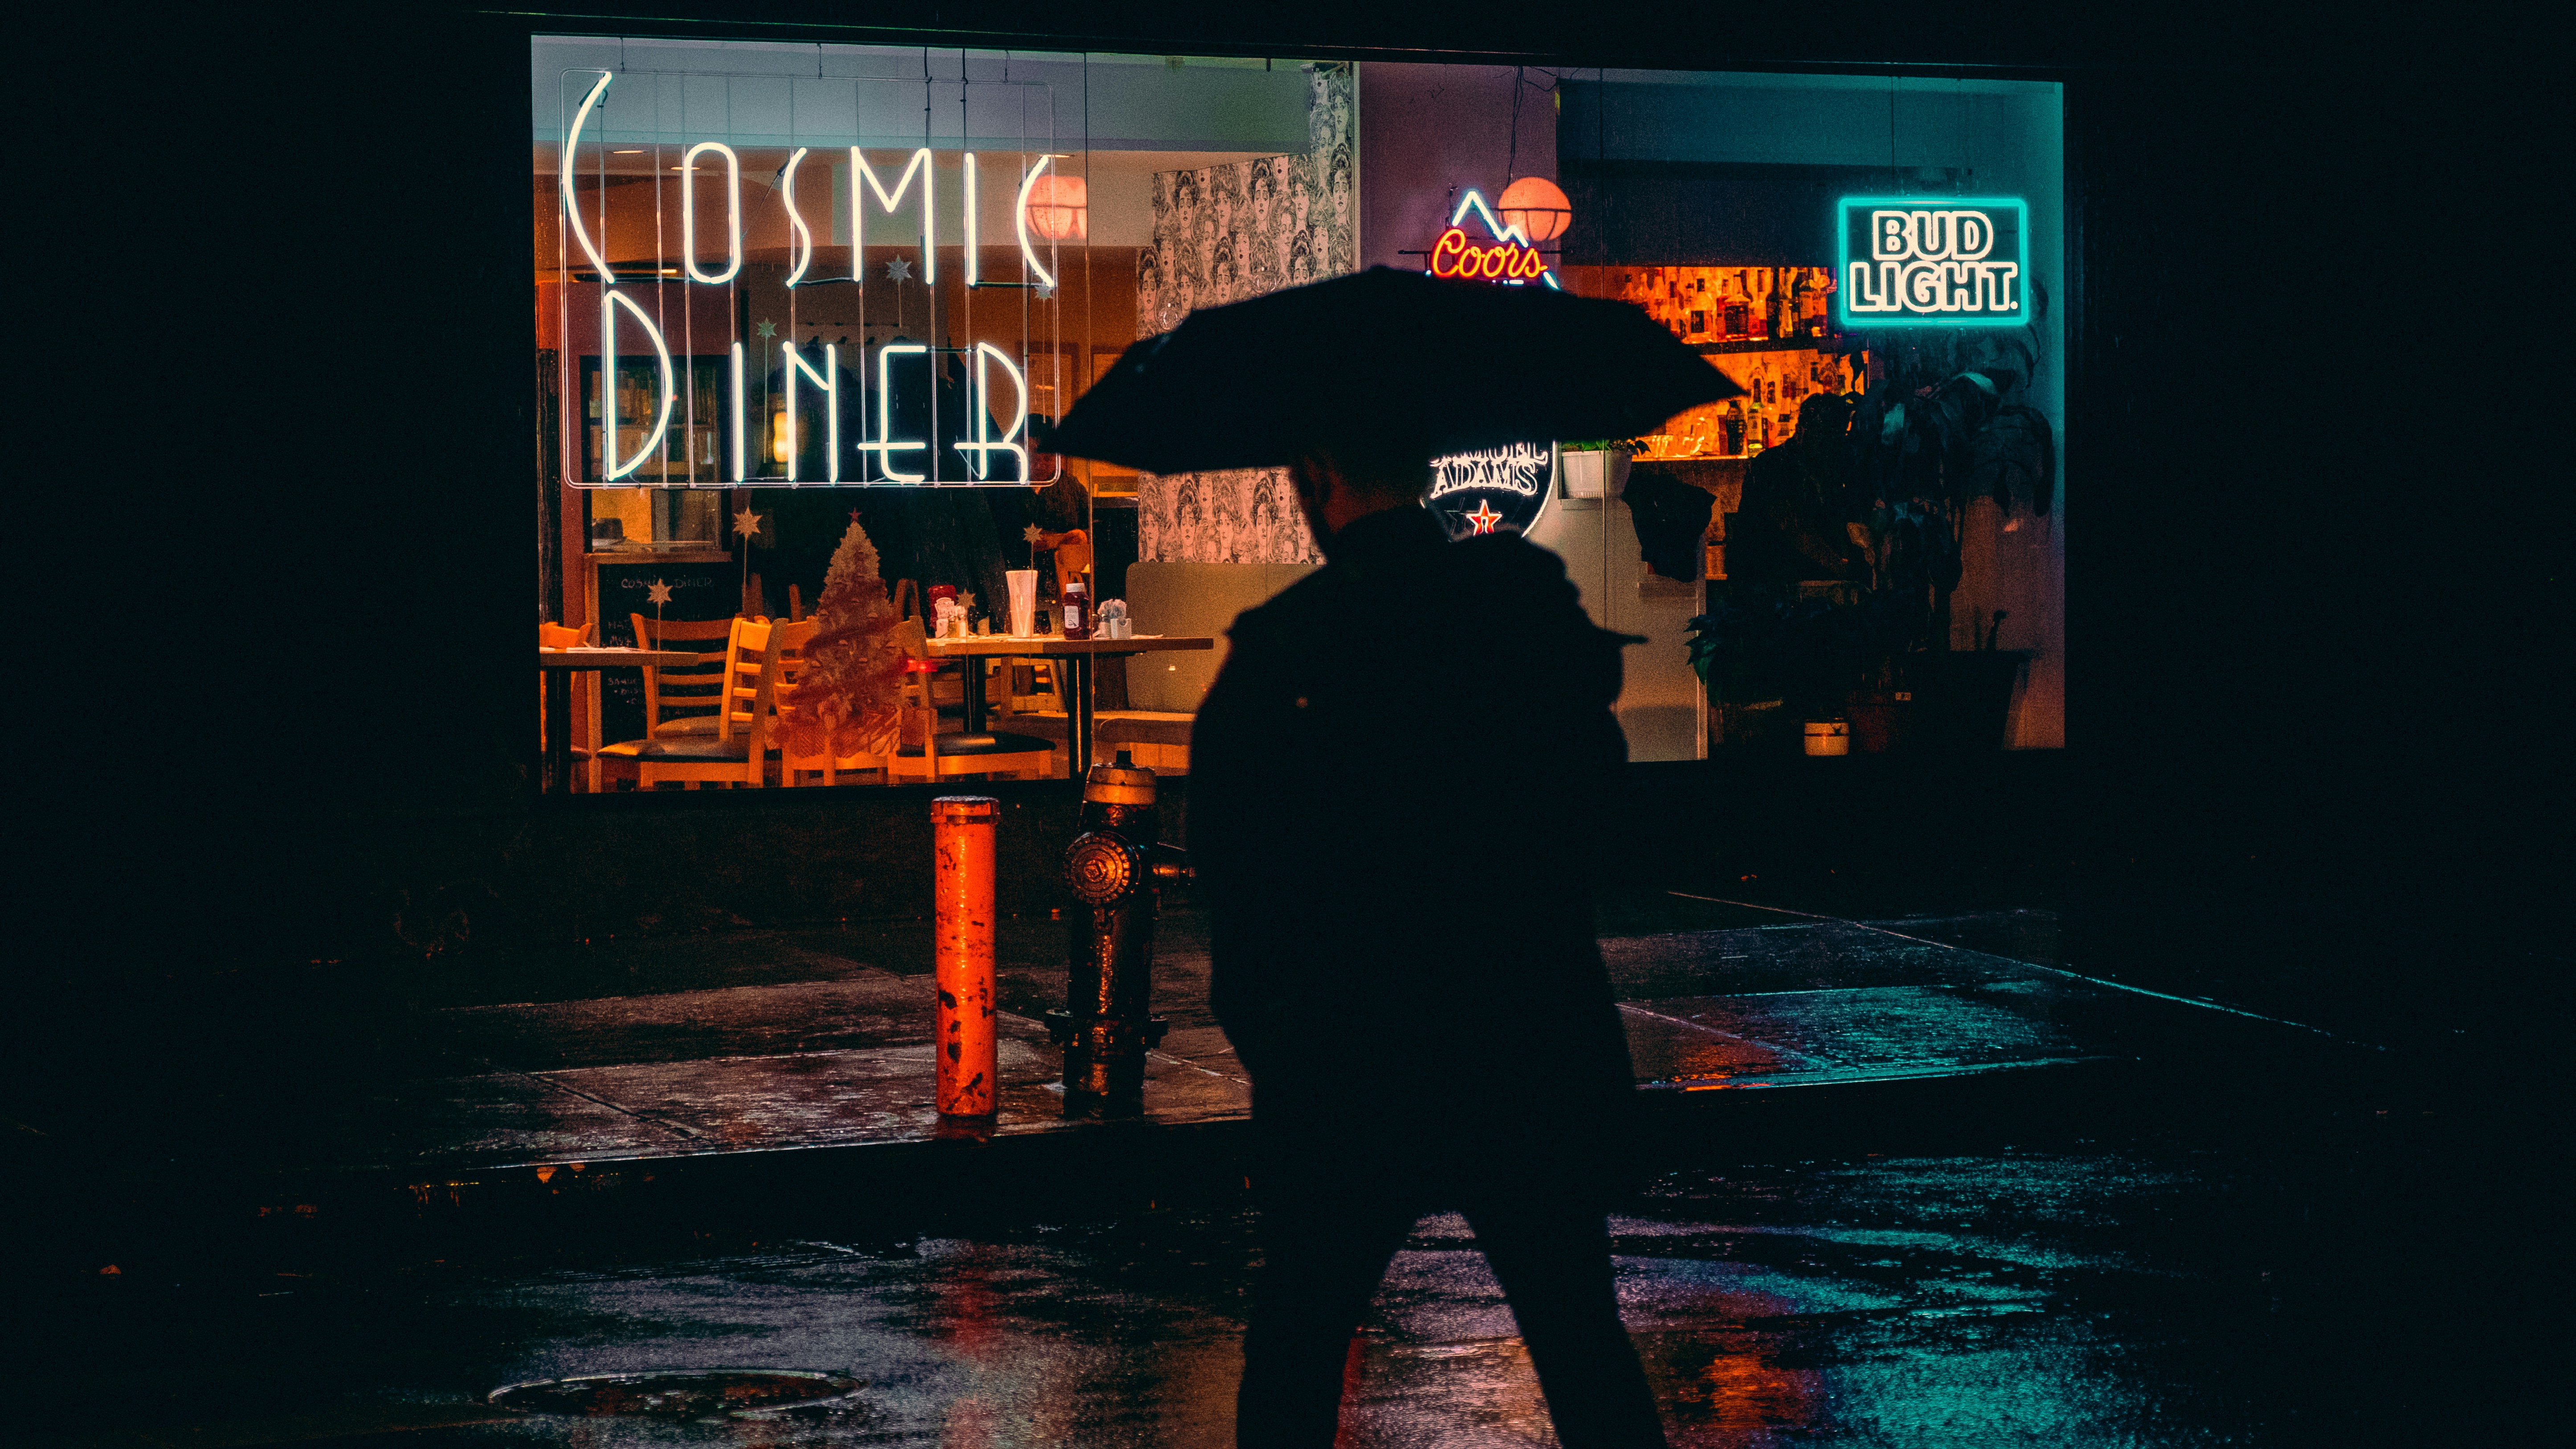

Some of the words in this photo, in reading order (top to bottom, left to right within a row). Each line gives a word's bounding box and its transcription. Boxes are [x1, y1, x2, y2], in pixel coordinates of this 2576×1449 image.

[563, 71, 1055, 288] COSMIC
[1431, 228, 1548, 278] Coors
[1872, 211, 1994, 261] BUD
[604, 290, 1028, 484] DINER
[1429, 459, 1538, 499] ADAMS
